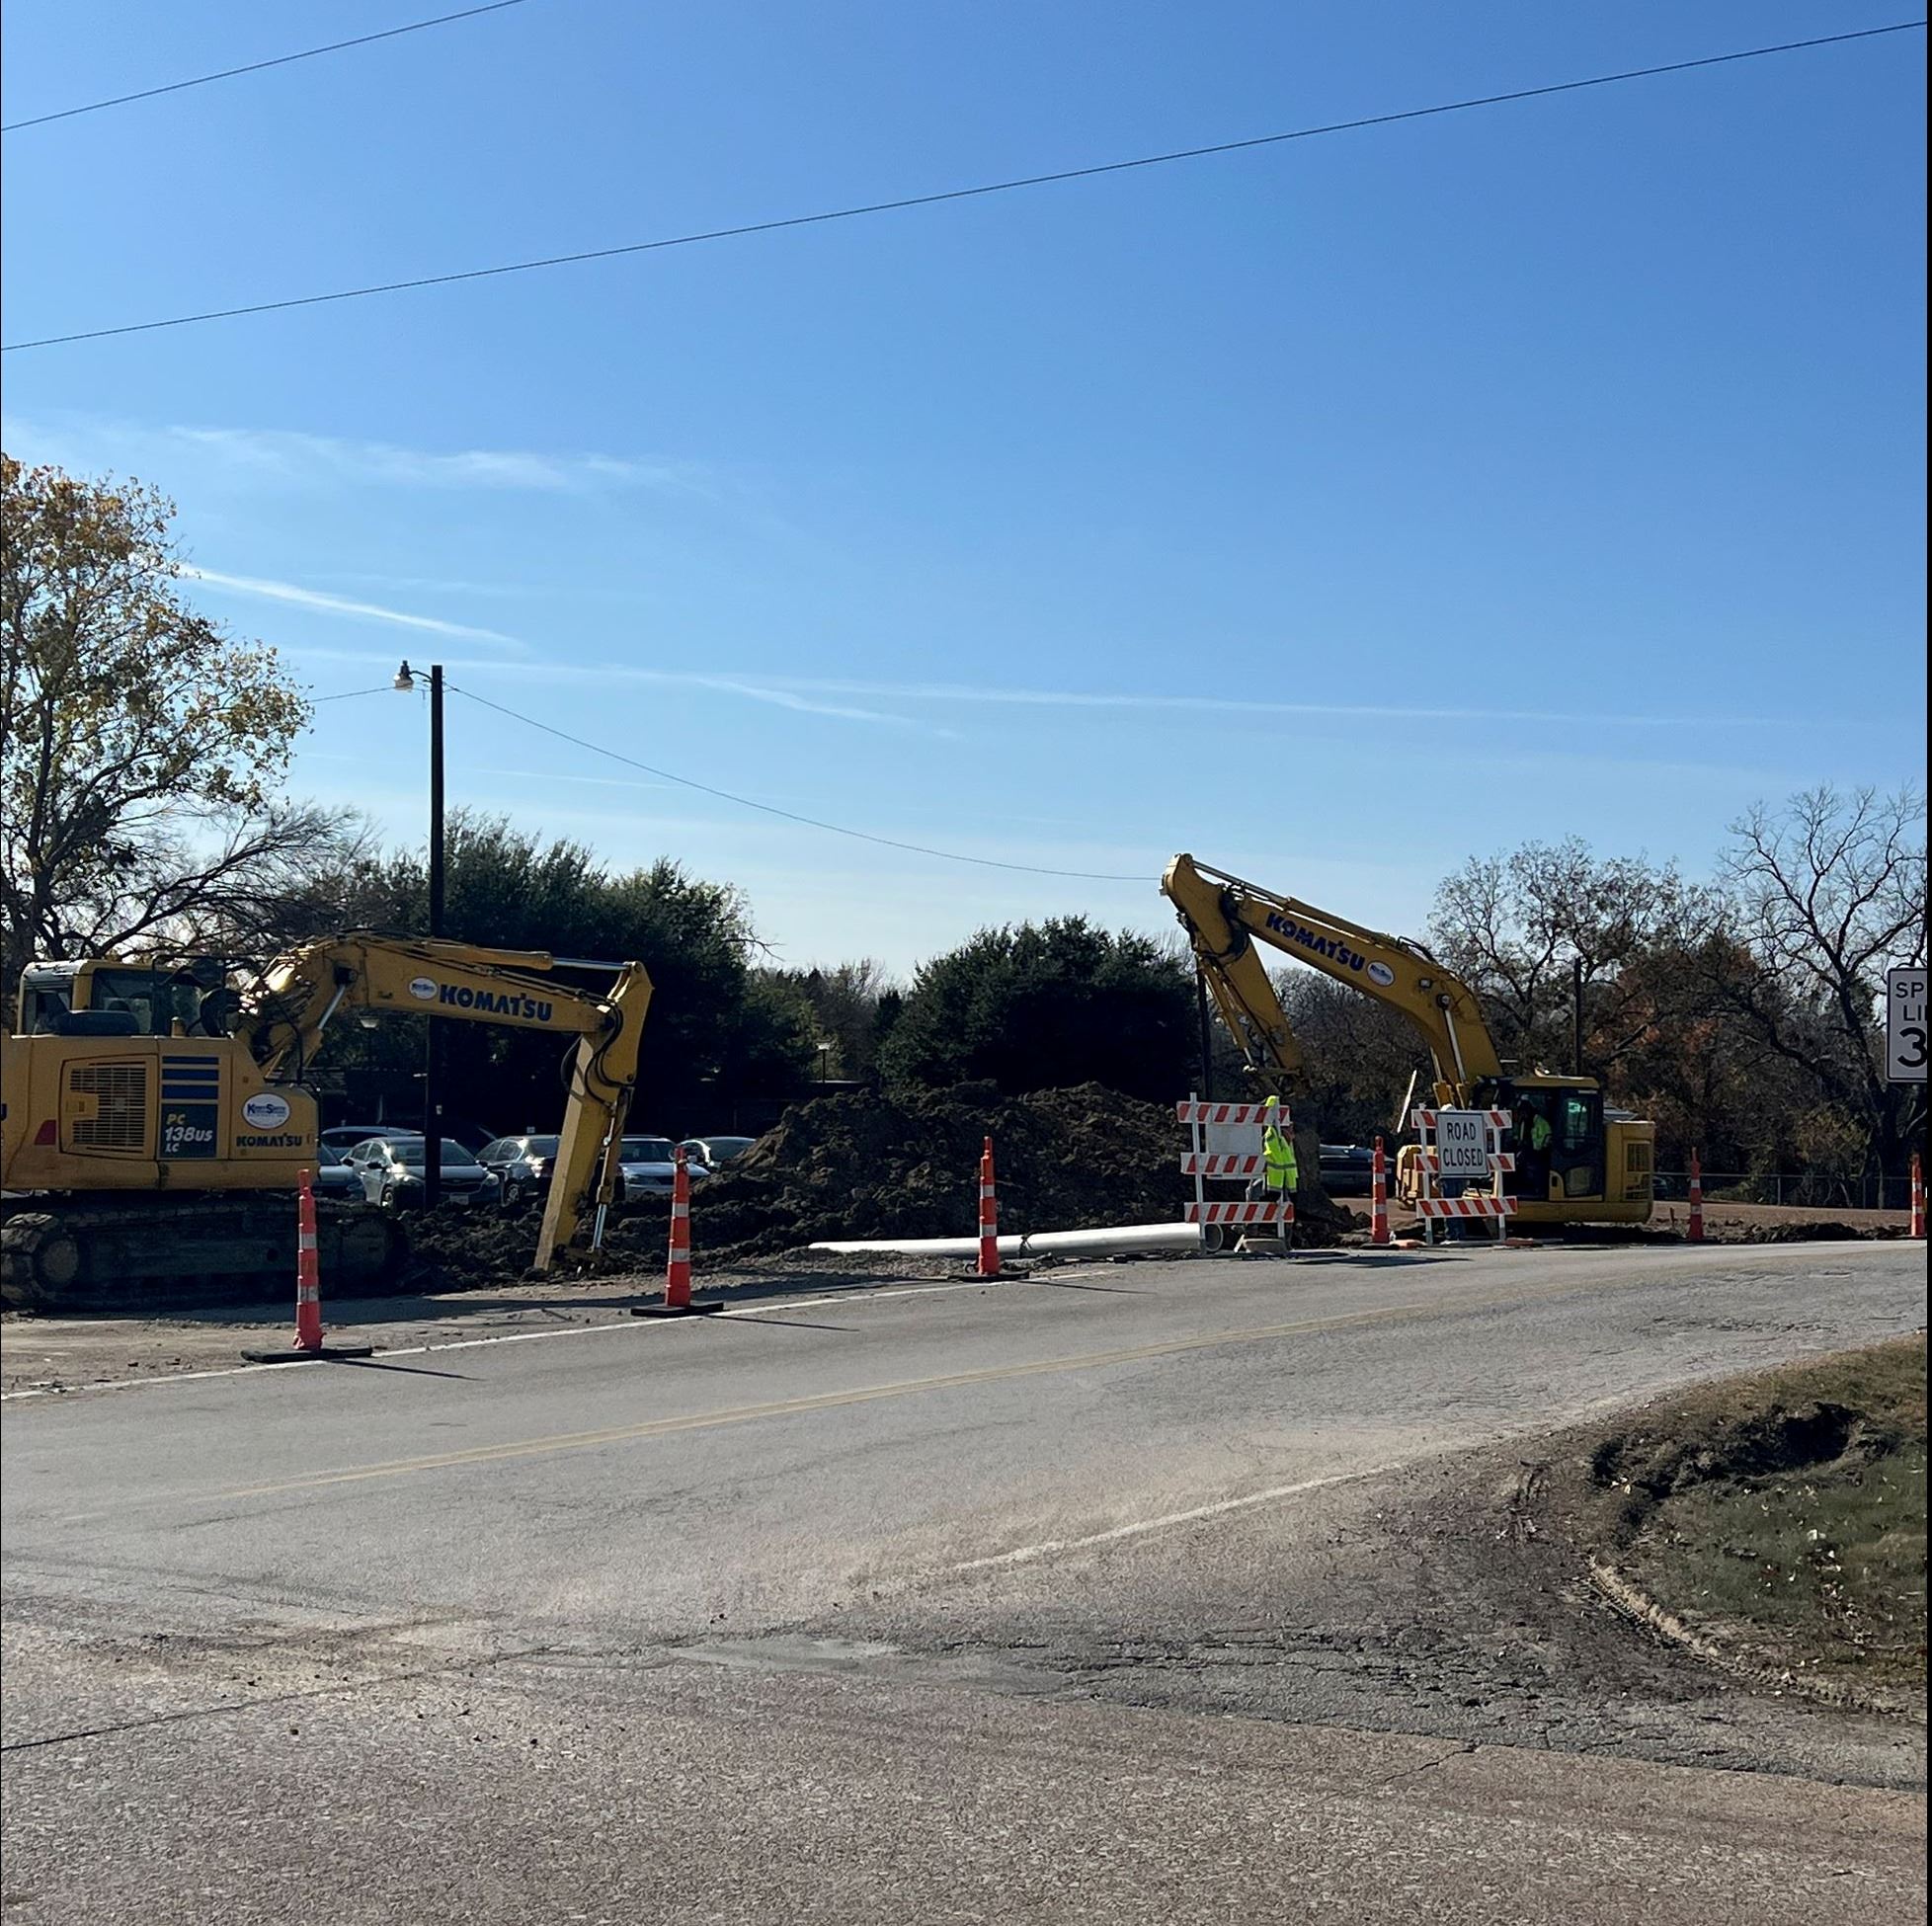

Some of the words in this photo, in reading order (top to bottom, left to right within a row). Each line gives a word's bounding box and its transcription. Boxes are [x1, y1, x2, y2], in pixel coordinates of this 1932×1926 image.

[1266, 912, 1365, 971] KOMATSU
[440, 984, 552, 1021] KOMATSU
[1903, 1004, 1927, 1021] LI
[167, 1113, 186, 1125] PC
[236, 1132, 302, 1147] KOMATSU
[1446, 1122, 1477, 1142] ROAD
[165, 1142, 180, 1153] LC
[1442, 1148, 1484, 1166] CLOSED
